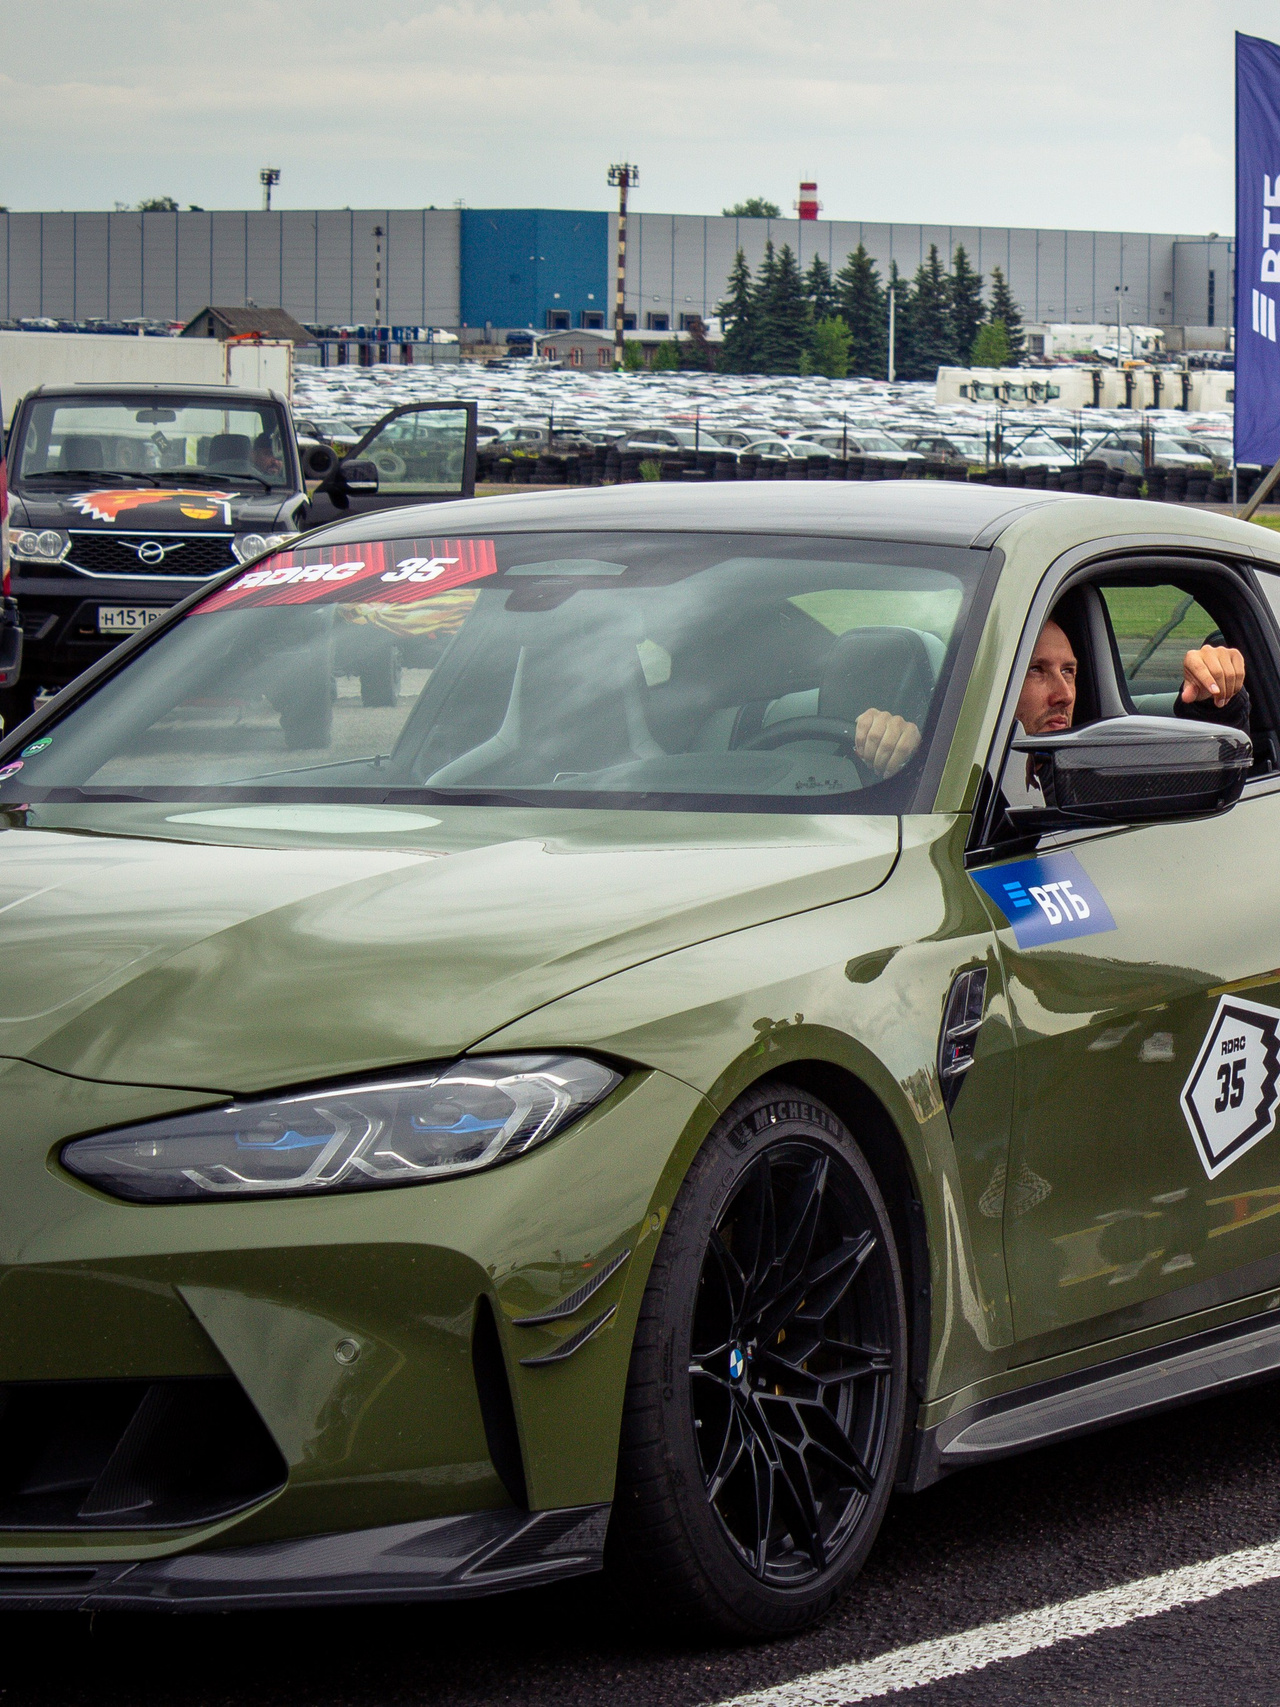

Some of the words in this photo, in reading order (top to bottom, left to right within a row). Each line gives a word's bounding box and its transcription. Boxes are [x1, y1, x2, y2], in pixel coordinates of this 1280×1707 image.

[381, 557, 460, 583] 35
[1028, 880, 1090, 925] ВТБ
[1214, 1057, 1247, 1114] 35
[753, 1101, 839, 1136] MICHELIN
